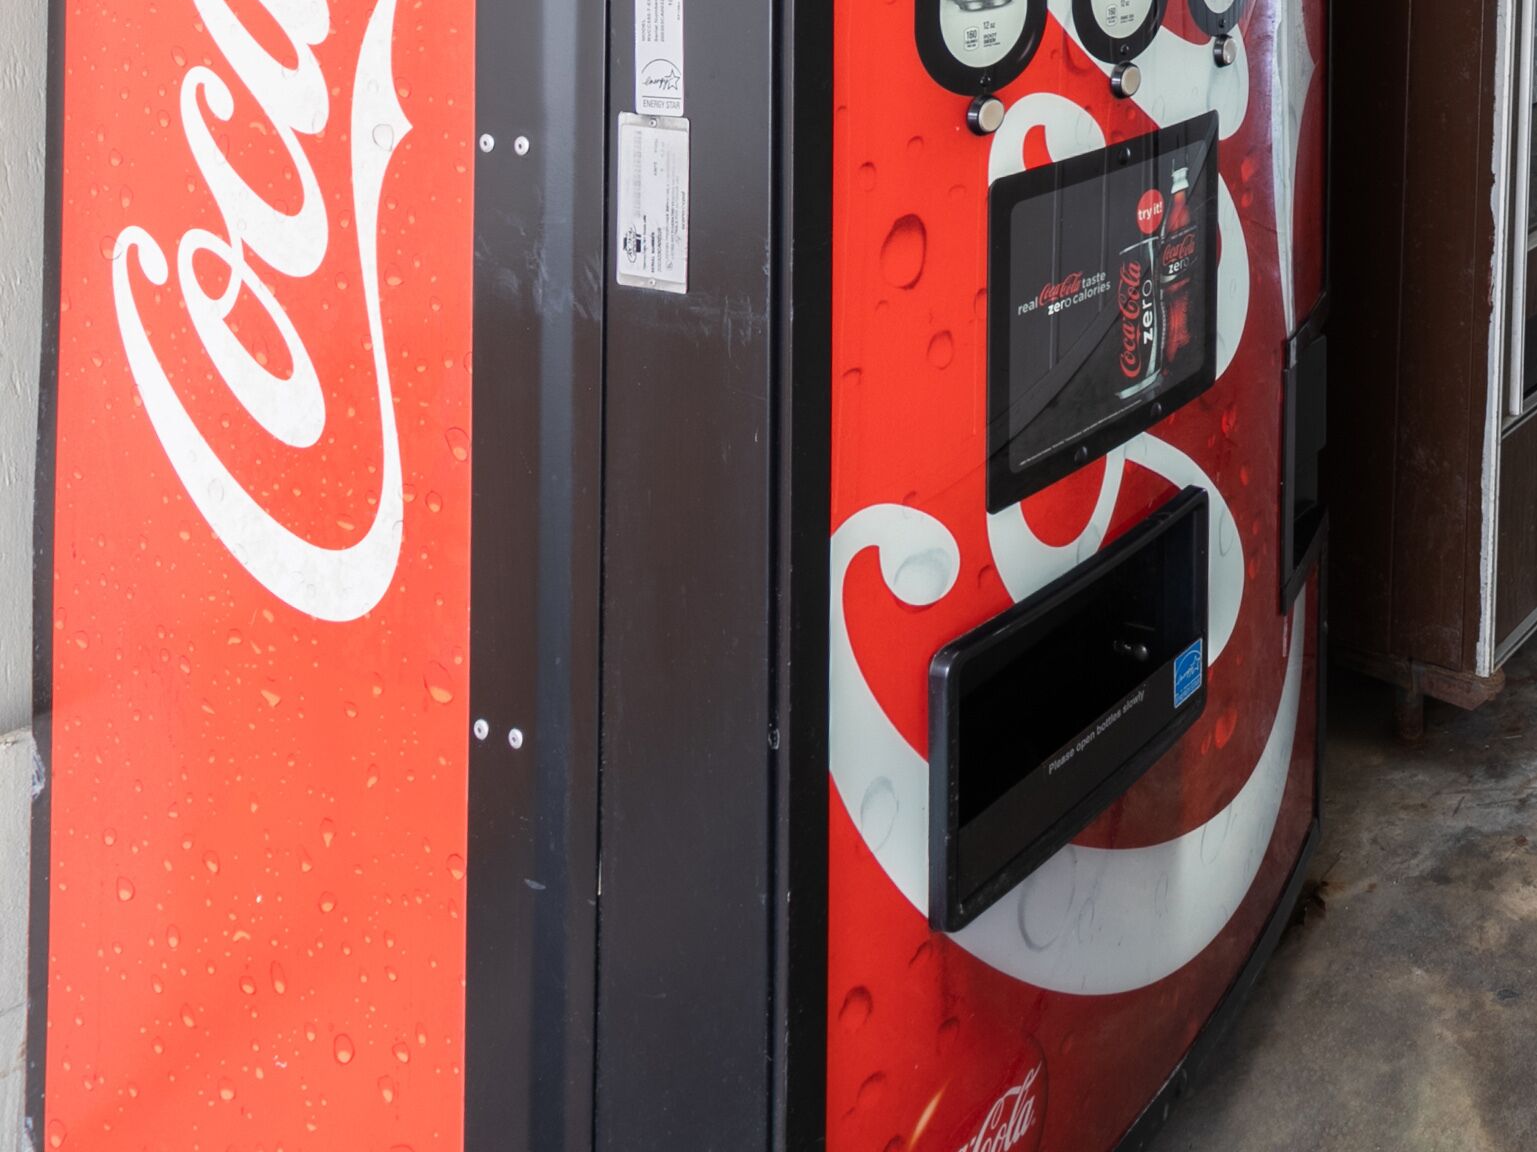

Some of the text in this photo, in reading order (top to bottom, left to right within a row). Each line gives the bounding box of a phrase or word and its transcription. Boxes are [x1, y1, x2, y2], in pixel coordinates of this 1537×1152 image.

[642, 98, 681, 110] ENERGY STAR
[1137, 201, 1163, 221] try it!
[1168, 256, 1190, 274] zero
[1017, 295, 1039, 315] real
[1082, 271, 1106, 288] taste
[1047, 281, 1111, 316] zero calories
[1142, 279, 1153, 345] zero
[1119, 260, 1141, 379] Coca-Cola
[1048, 747, 1075, 775] Please
[1076, 731, 1096, 752] open
[1096, 708, 1122, 735] bottles
[1122, 689, 1145, 714] slowly
